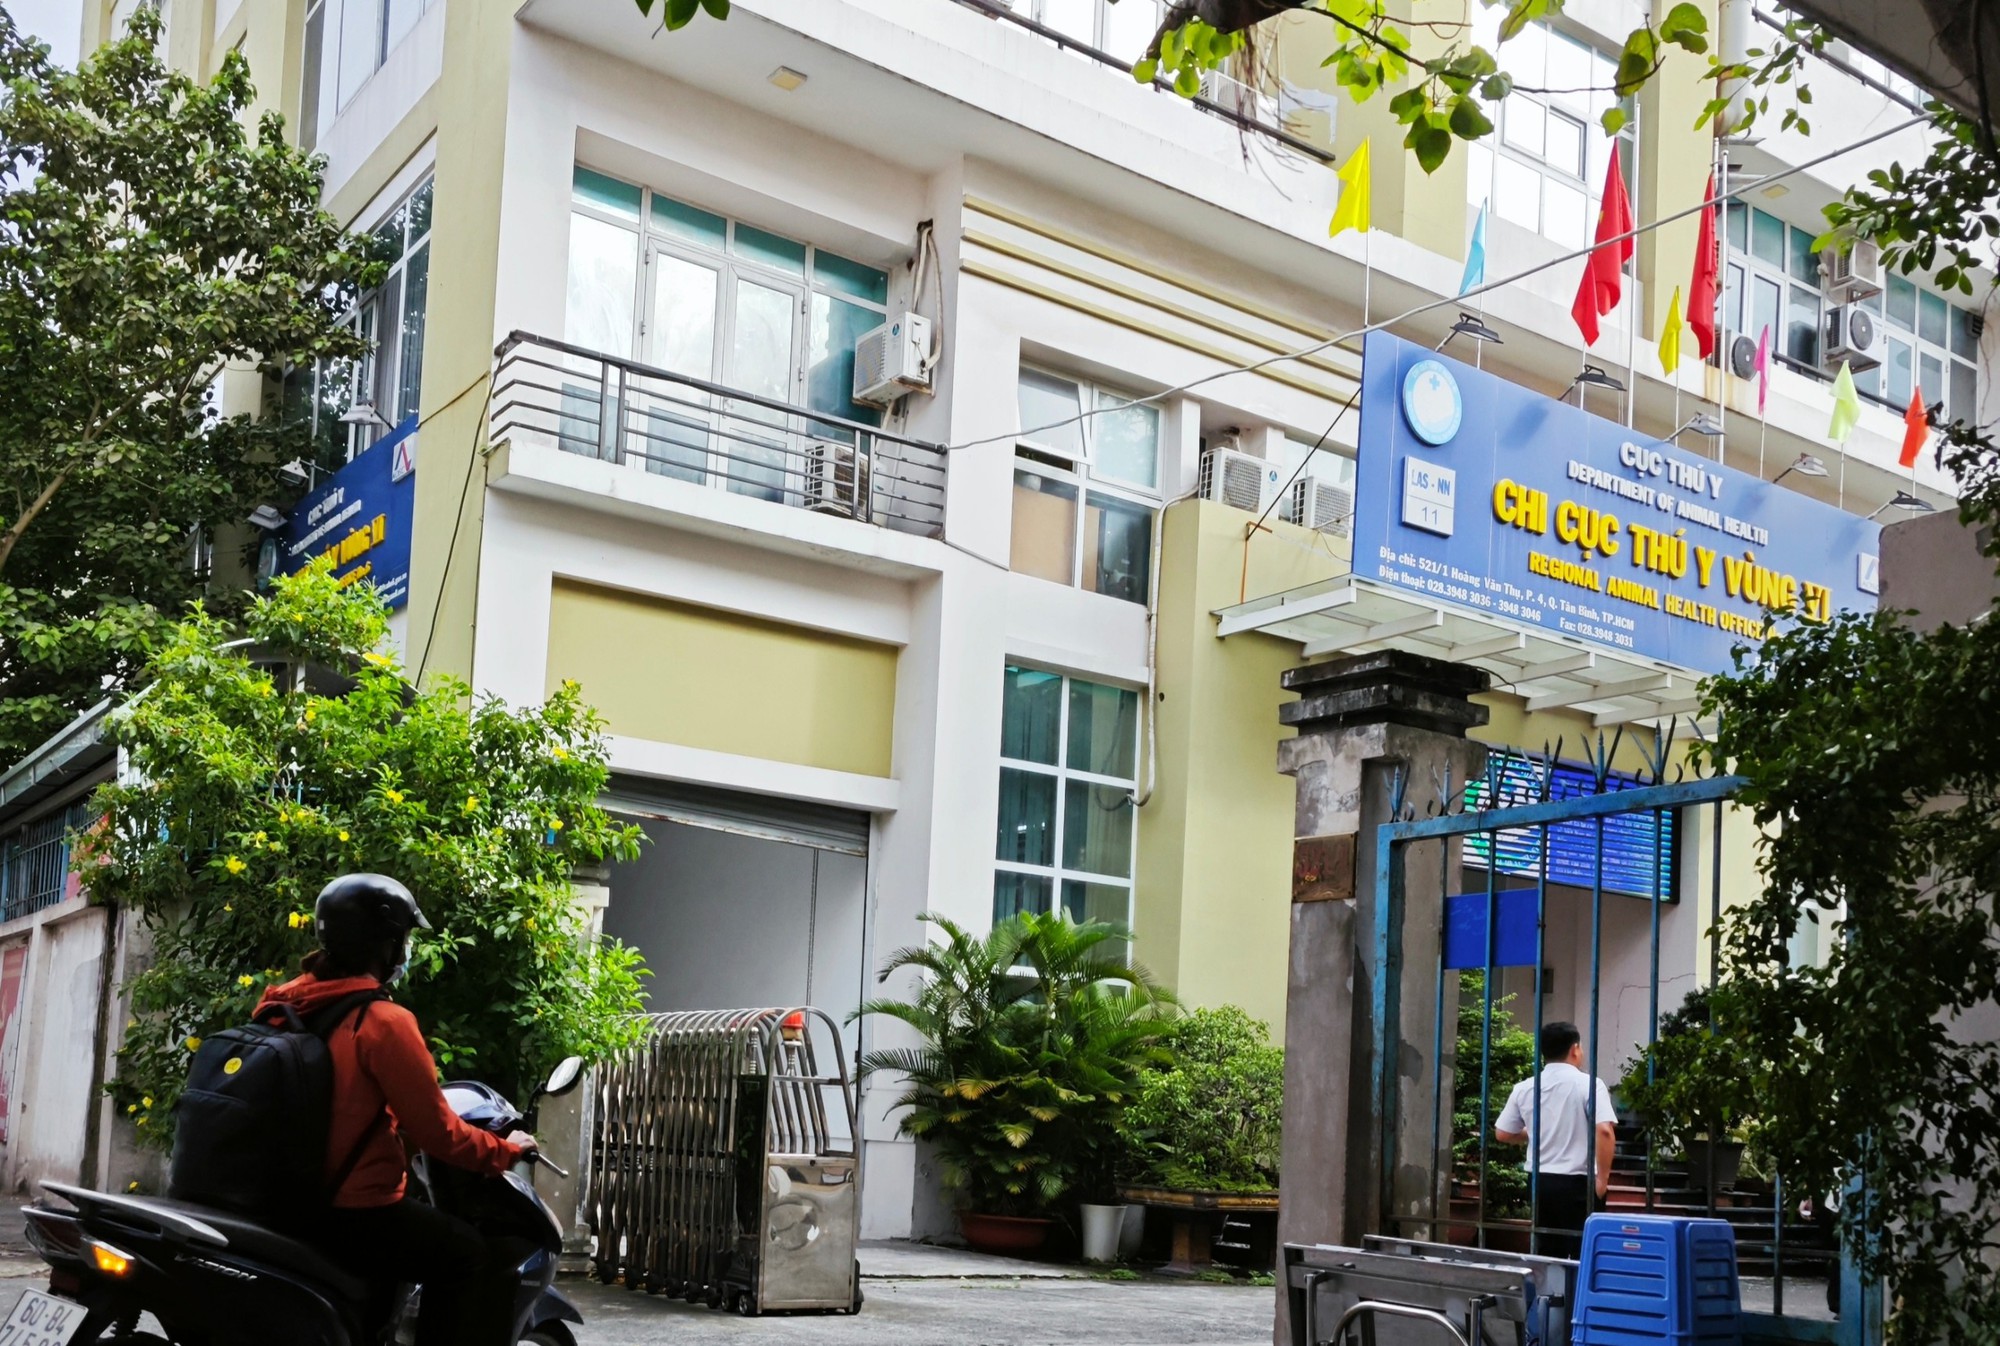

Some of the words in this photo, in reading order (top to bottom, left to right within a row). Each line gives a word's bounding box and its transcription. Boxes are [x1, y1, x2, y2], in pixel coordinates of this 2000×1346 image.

[1437, 477, 1451, 497] NN
[1567, 459, 1656, 506] DEPARTMENT
[1656, 492, 1675, 512] OF
[1676, 499, 1723, 531] ANIMAL
[1723, 515, 1769, 546] HEALTH
[1619, 441, 1663, 478] CỤC
[1665, 457, 1705, 494] THÚ
[1708, 473, 1724, 500] Y
[1421, 505, 1438, 525] 11
[1493, 478, 1548, 536] CHI
[1555, 500, 1620, 561] CỤC
[1628, 522, 1688, 580] THÚ
[1694, 545, 1716, 588] Y
[1723, 552, 1797, 613] VÙNG
[1379, 546, 1396, 563] Địa
[1419, 557, 1449, 577] 521/1
[1451, 567, 1481, 588] Hoàng
[1484, 577, 1502, 593] Văn
[1525, 589, 1535, 602] P.
[1548, 596, 1558, 610] Q.
[1559, 599, 1576, 614] Tân
[1578, 604, 1600, 622] Bình,
[1601, 611, 1635, 631] TP.HCM
[1379, 564, 1399, 583] Điện
[1427, 578, 1468, 600] 028.3948
[1469, 590, 1491, 607] 3036
[1498, 599, 1519, 615] 3948
[1559, 617, 1576, 632] Fax:
[1614, 633, 1634, 648] 3031
[1528, 551, 1603, 592] REGIONAL
[1606, 575, 1661, 610] ANIMAL
[1664, 593, 1717, 628] HEALTH
[1718, 610, 1765, 641] OFFICE
